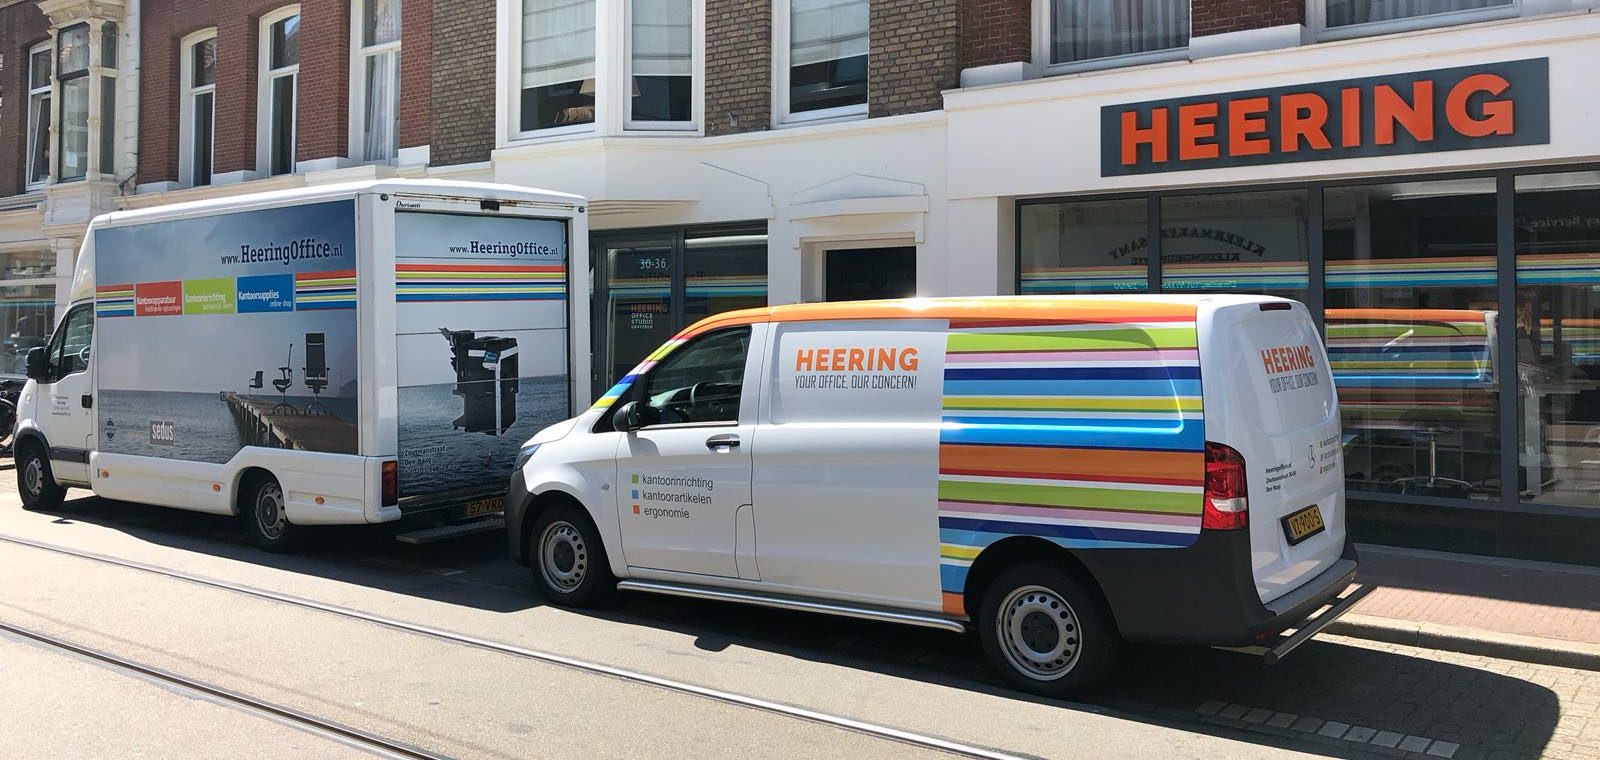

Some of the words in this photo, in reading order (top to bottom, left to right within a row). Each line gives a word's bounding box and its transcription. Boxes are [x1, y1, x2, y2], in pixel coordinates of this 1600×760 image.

[1120, 73, 1515, 165] HEERING
[221, 238, 343, 265] www.HeeringOffice.nl
[449, 241, 558, 257] www.HeeringOffice.nl
[640, 258, 666, 270] 30-36
[238, 290, 280, 301] Kantoorsupplies
[631, 304, 668, 312] HEERING
[795, 347, 919, 371] HEERING
[1261, 345, 1315, 374] HEERING
[795, 375, 816, 389] YOUR
[818, 375, 848, 390] OFFICE,
[851, 375, 870, 389] OUR
[872, 375, 917, 390] CONCERN!
[152, 421, 174, 441] sedus
[642, 474, 714, 491] kantoorinrichting
[642, 490, 712, 504] kantoorartikelen
[644, 506, 690, 519] ergonomie
